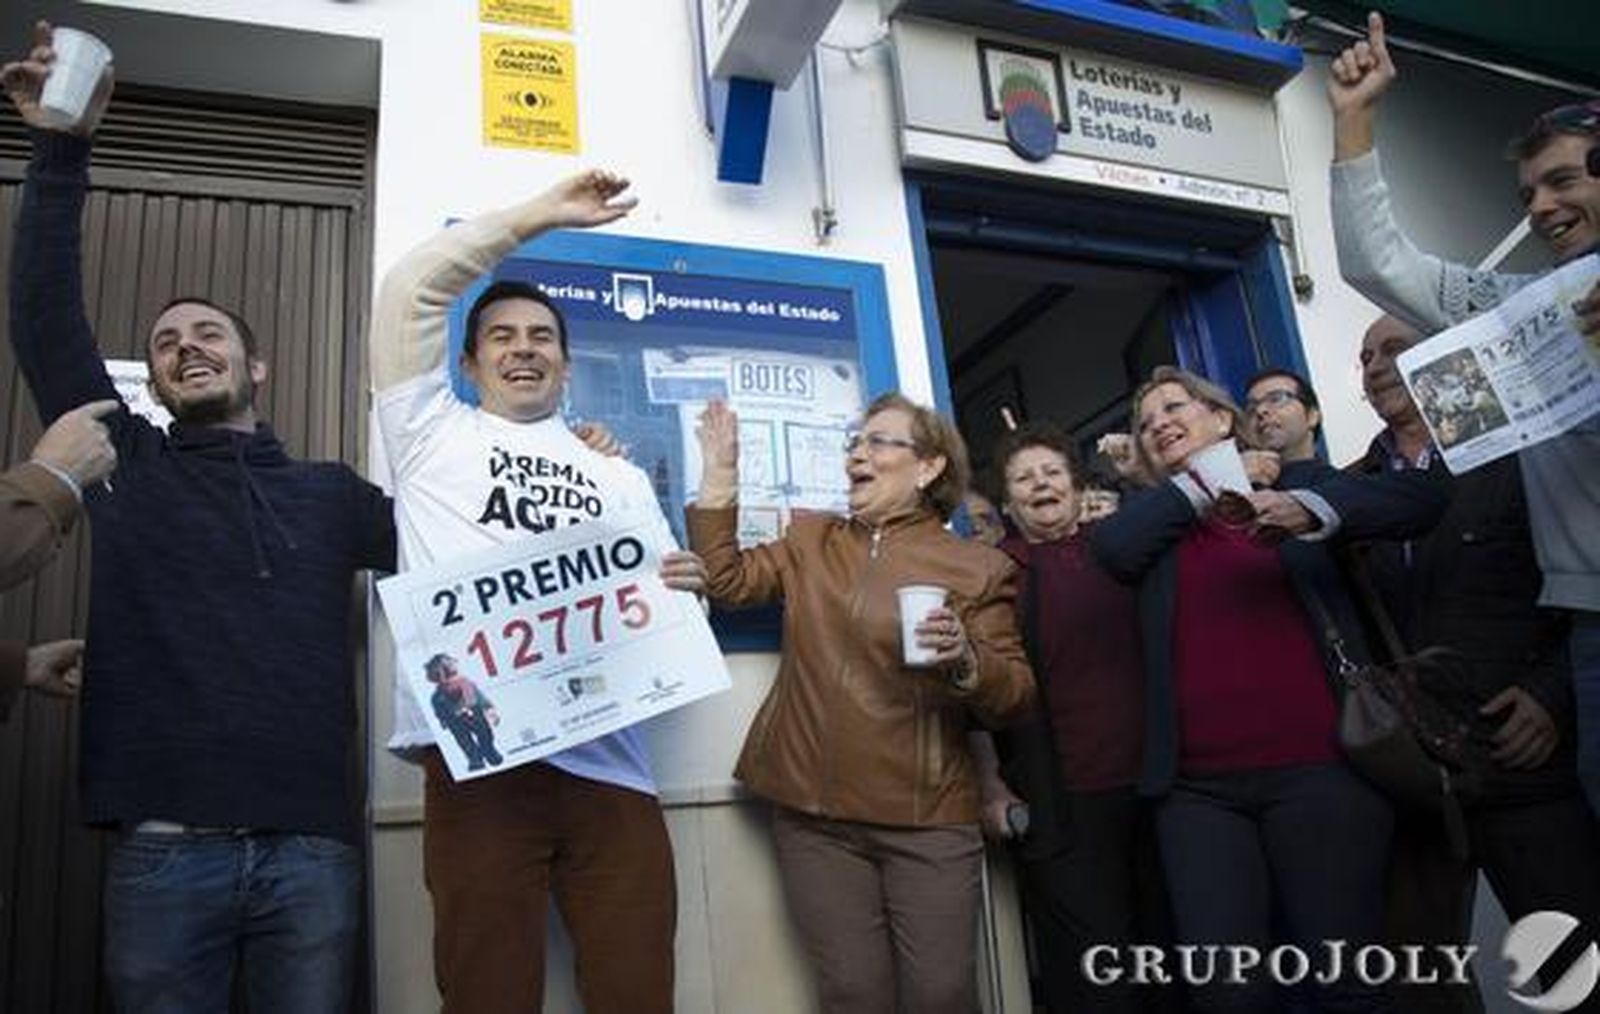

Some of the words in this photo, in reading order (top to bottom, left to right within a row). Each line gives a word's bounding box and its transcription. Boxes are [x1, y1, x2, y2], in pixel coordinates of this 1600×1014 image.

[494, 59, 563, 75] CONECTADA
[500, 48, 558, 64] ALARMA
[1166, 83, 1182, 104] y
[1076, 89, 1177, 125] Apuestas
[1182, 113, 1213, 134] del
[1079, 117, 1157, 149] Estado
[538, 283, 597, 301] erías
[601, 290, 613, 305] y
[655, 292, 741, 315] Apuestas
[746, 301, 775, 316] del
[779, 302, 841, 322] Estado
[740, 362, 807, 395] BOTES
[473, 536, 645, 614] PREMIO
[467, 583, 651, 679] 12775
